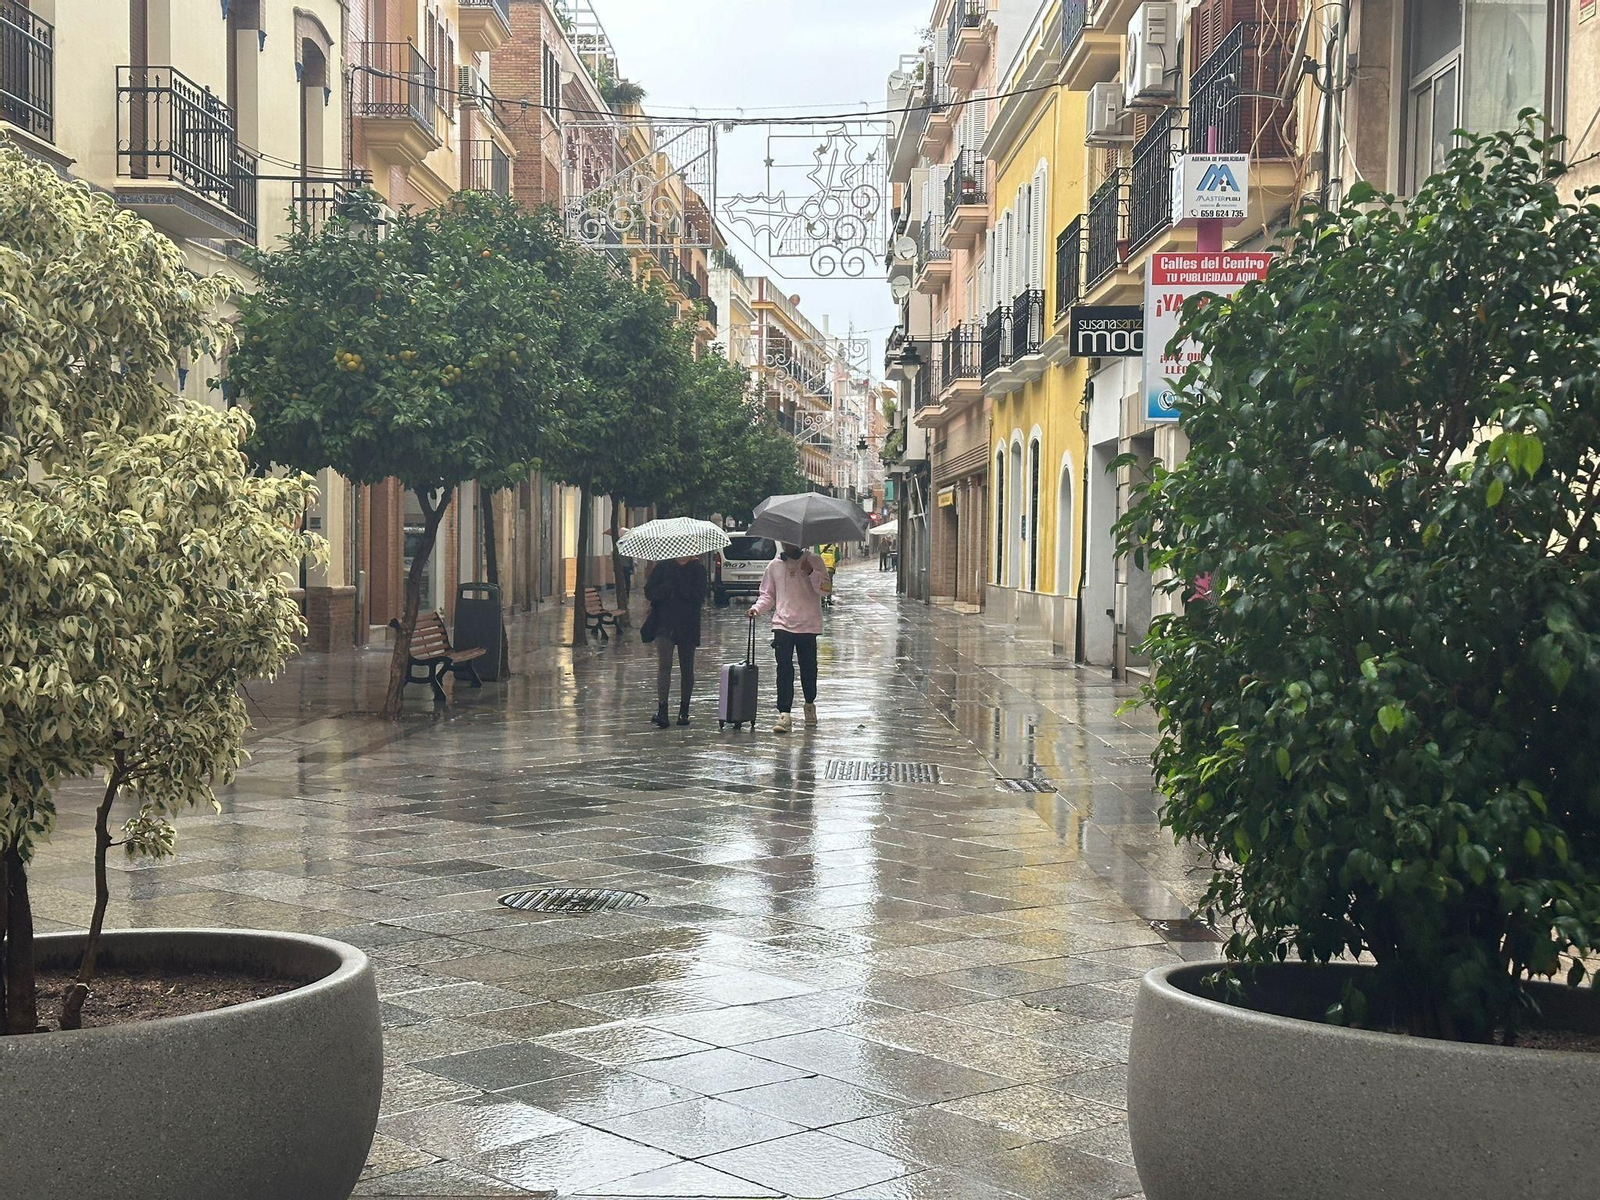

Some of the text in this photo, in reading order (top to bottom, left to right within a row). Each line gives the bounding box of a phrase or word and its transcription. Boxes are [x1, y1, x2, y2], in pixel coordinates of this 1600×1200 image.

[1160, 256, 1265, 270] Calles del Centro
[1166, 273, 1177, 282] TU
[1180, 273, 1233, 282] PUBLICIDAD
